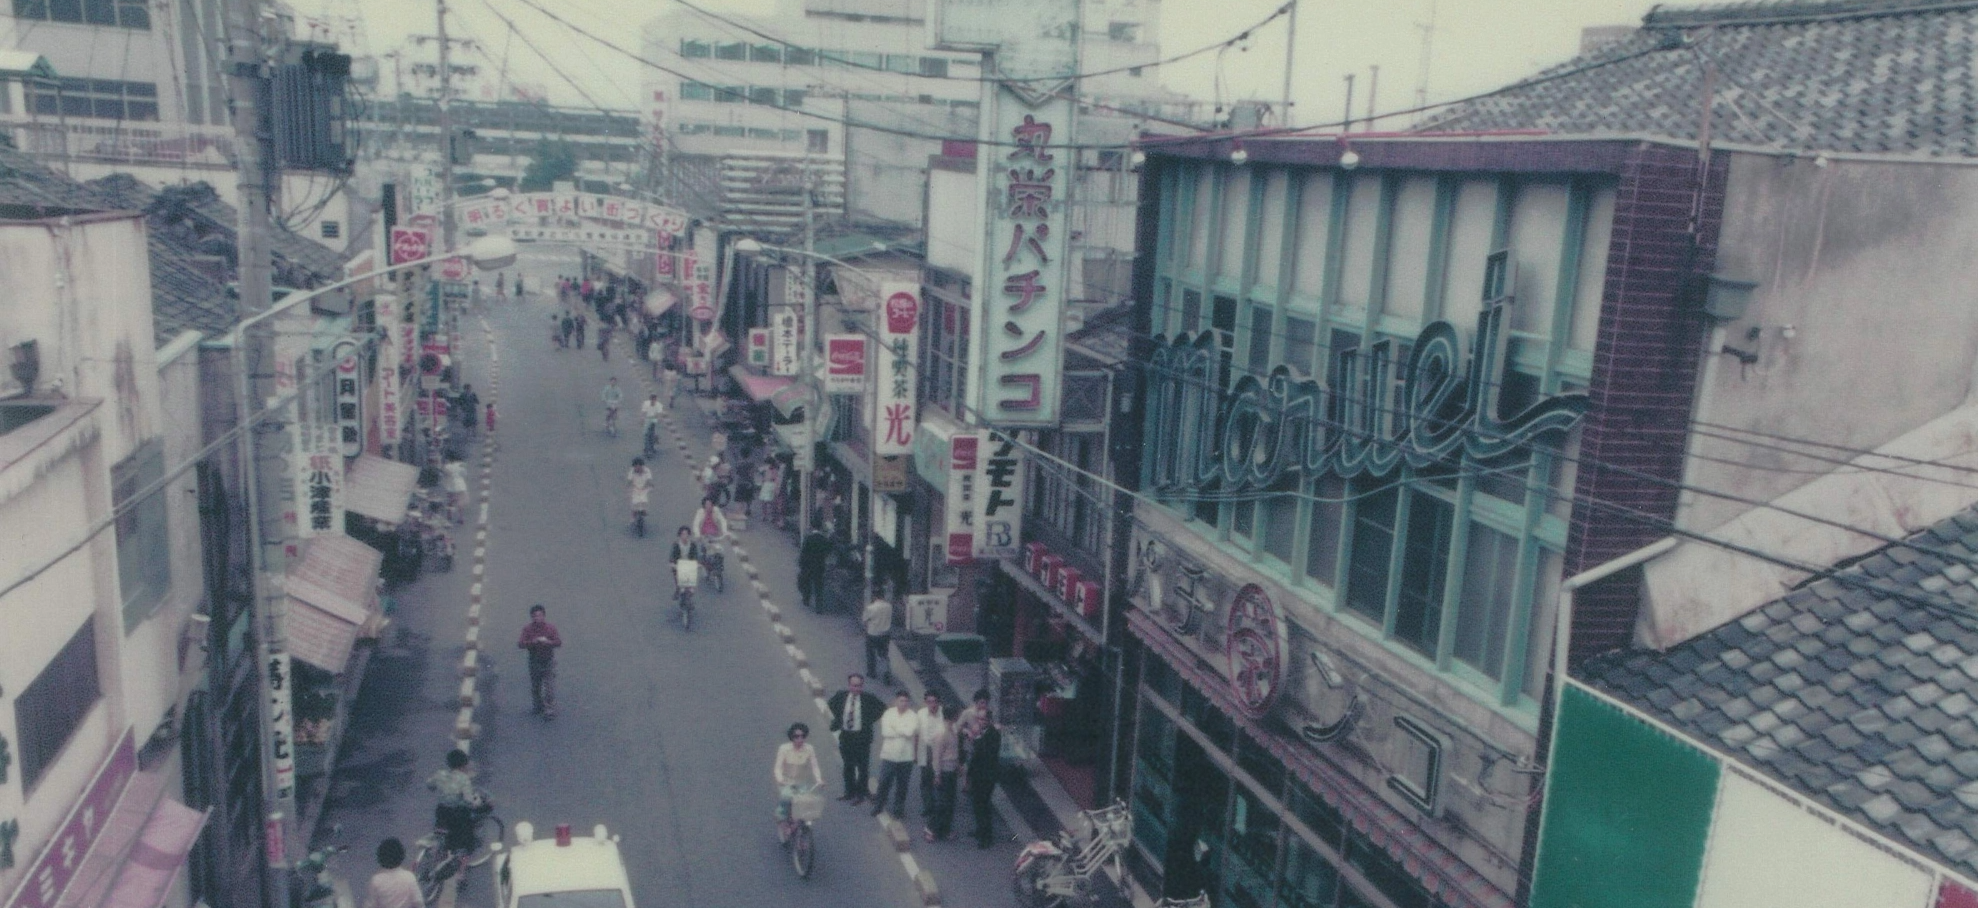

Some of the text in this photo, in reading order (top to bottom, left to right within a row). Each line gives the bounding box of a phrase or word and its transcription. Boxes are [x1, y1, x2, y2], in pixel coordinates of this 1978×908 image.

[998, 113, 1053, 411] 丸栄パチンコ
[884, 403, 912, 446] 光
